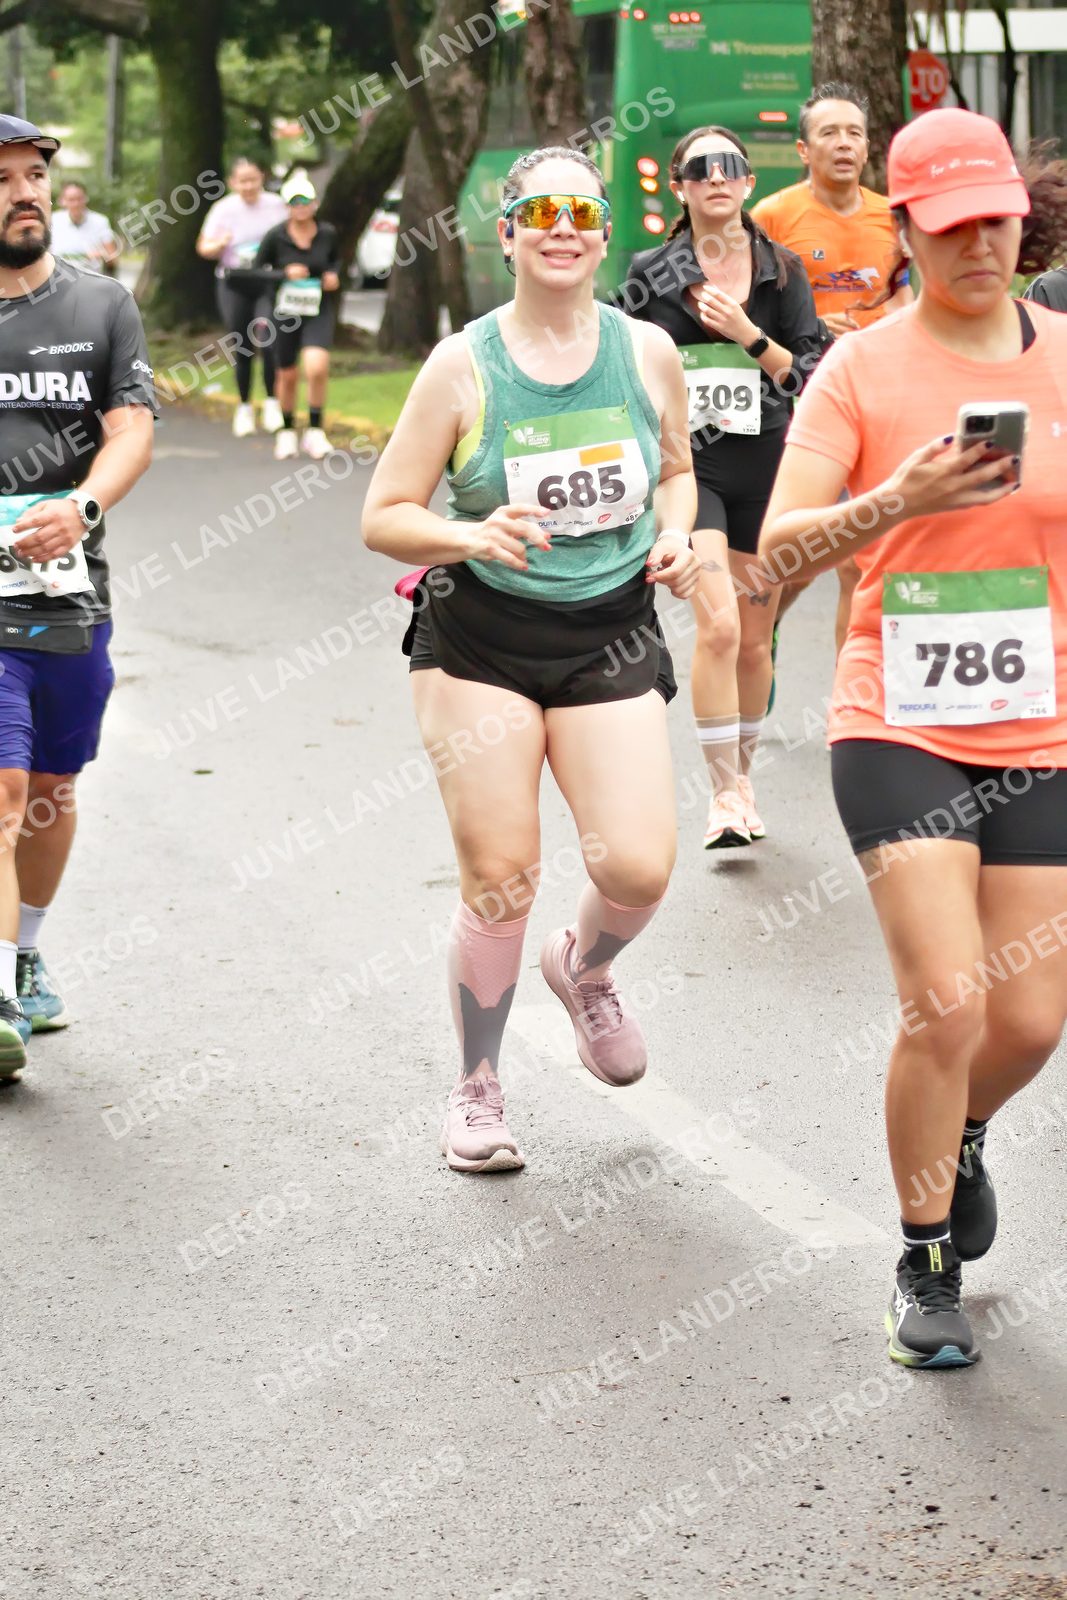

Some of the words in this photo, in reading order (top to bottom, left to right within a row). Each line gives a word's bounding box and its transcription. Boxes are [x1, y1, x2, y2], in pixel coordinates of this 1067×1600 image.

[50, 342, 94, 355] BROOKS
[0, 401, 46, 409] NTEADORES
[687, 385, 753, 412] 309
[537, 465, 626, 511] 685
[915, 638, 1026, 688] 786
